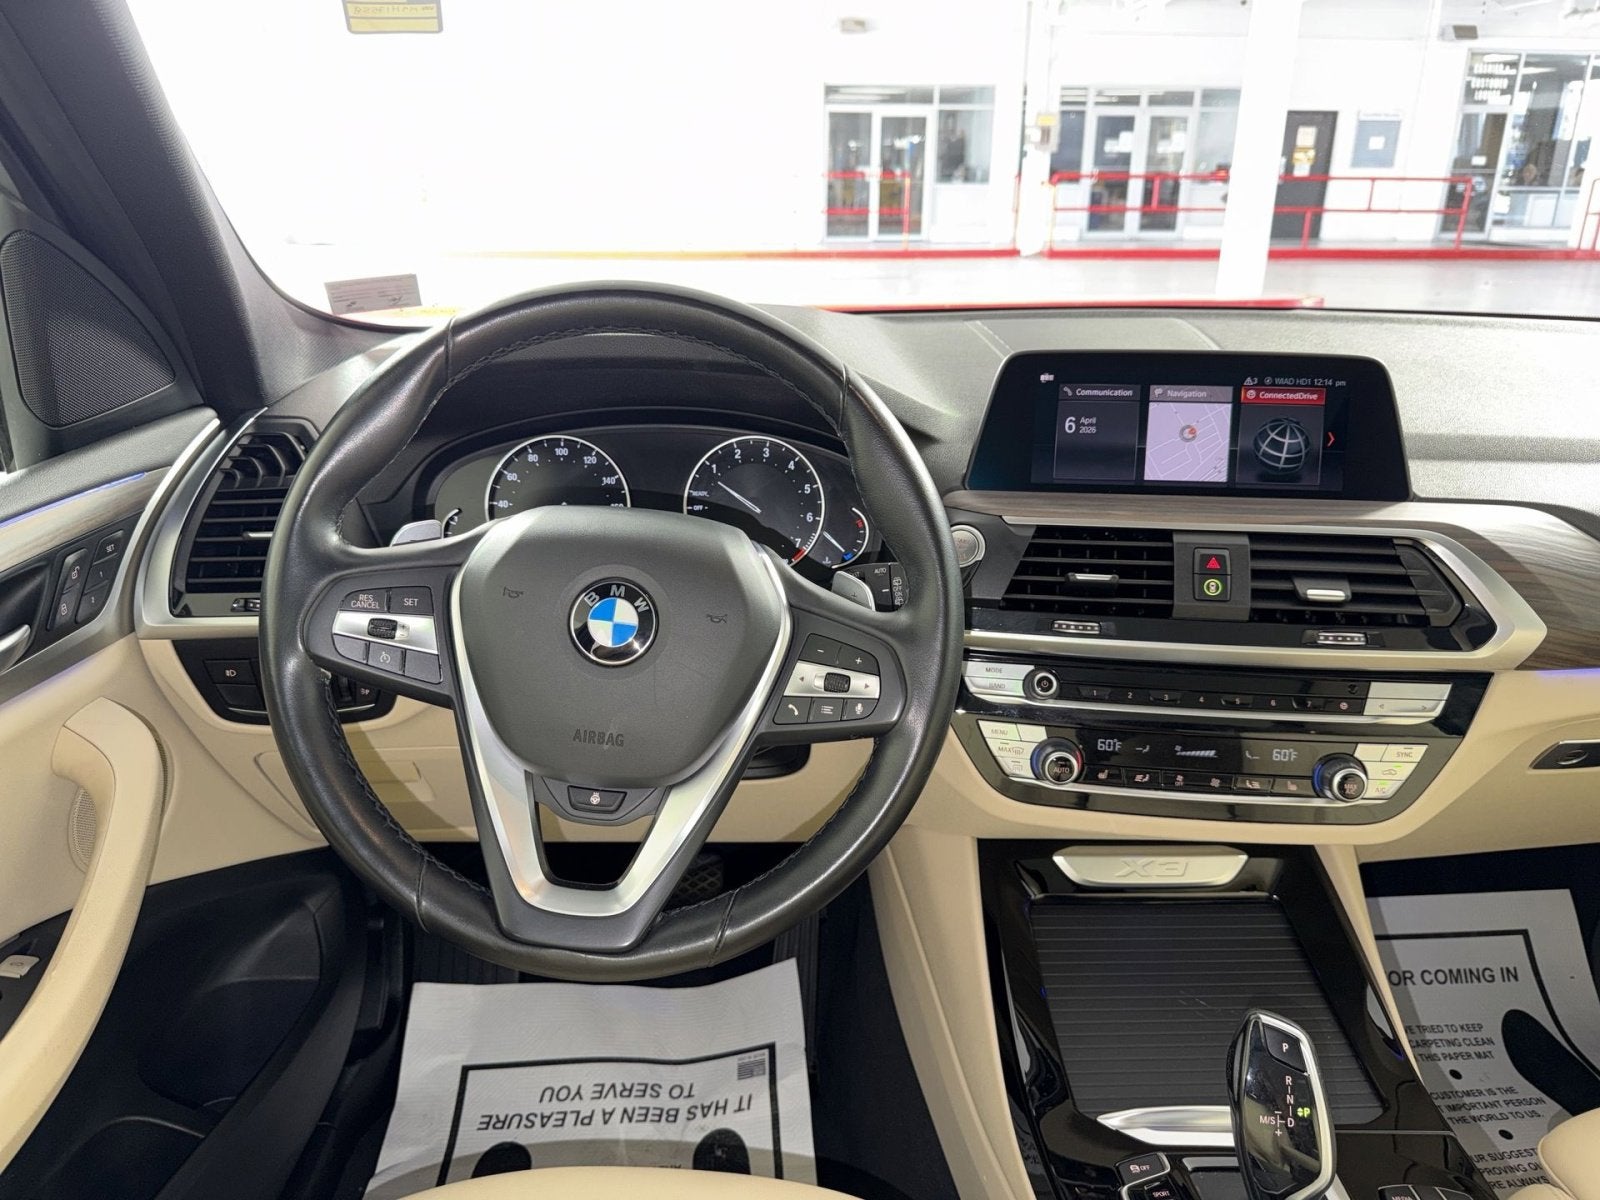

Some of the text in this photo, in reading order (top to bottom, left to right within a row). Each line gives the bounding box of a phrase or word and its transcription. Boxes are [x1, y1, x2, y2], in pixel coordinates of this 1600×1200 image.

[1075, 387, 1133, 397] Communication
[1167, 389, 1207, 399] Navigation
[1259, 391, 1318, 400] ConnectedDrive
[1064, 416, 1076, 434] 6
[1079, 416, 1097, 425] April
[1079, 426, 1097, 434] 2026
[555, 448, 569, 456] 100
[734, 449, 742, 459] 2
[763, 448, 770, 457] 3
[527, 454, 539, 463] 80
[583, 456, 598, 465] 120
[711, 464, 717, 473] 1
[788, 461, 795, 471] 4
[507, 473, 518, 481] 60
[602, 477, 616, 485] 140
[804, 485, 811, 494] 5
[497, 500, 508, 508] 40
[806, 513, 813, 522] 6
[795, 538, 802, 548] 7
[105, 544, 115, 553] SET
[359, 594, 374, 602] RES
[403, 598, 419, 606] SET
[584, 585, 650, 613] BMW
[350, 601, 380, 609] CANCEL
[991, 728, 1009, 736] MENU
[572, 728, 625, 748] AIRBAG
[1113, 858, 1189, 878] X3
[1420, 967, 1496, 986] COMING
[1500, 966, 1519, 983] IN
[1416, 1024, 1444, 1034] TRIED
[1444, 1023, 1458, 1033] TO
[1459, 1023, 1484, 1033] KEEP
[1462, 1037, 1495, 1047] CLEAN
[1282, 1043, 1289, 1053] P
[1418, 1050, 1495, 1062] THIS PAPER MAT
[1286, 1075, 1292, 1085] R
[538, 1082, 696, 1104] TO SERVE YOU
[1429, 1086, 1519, 1101] CUSTOMER IS THE
[1286, 1094, 1294, 1105] N
[1446, 1100, 1503, 1113] IMPORTANT
[1503, 1097, 1547, 1108] PERSON
[476, 1093, 753, 1132] IT HAS BEEN A PLEASURE
[1303, 1107, 1311, 1118] P
[1447, 1109, 1545, 1125] THE WORLD TO US.
[1259, 1115, 1276, 1124] M/S
[1287, 1118, 1295, 1127] D
[1487, 1147, 1538, 1161] SUGGEST
[1480, 1163, 1528, 1176] PROVING
[1506, 1175, 1551, 1189] ALWAYS
[1152, 1190, 1170, 1198] SPORT
